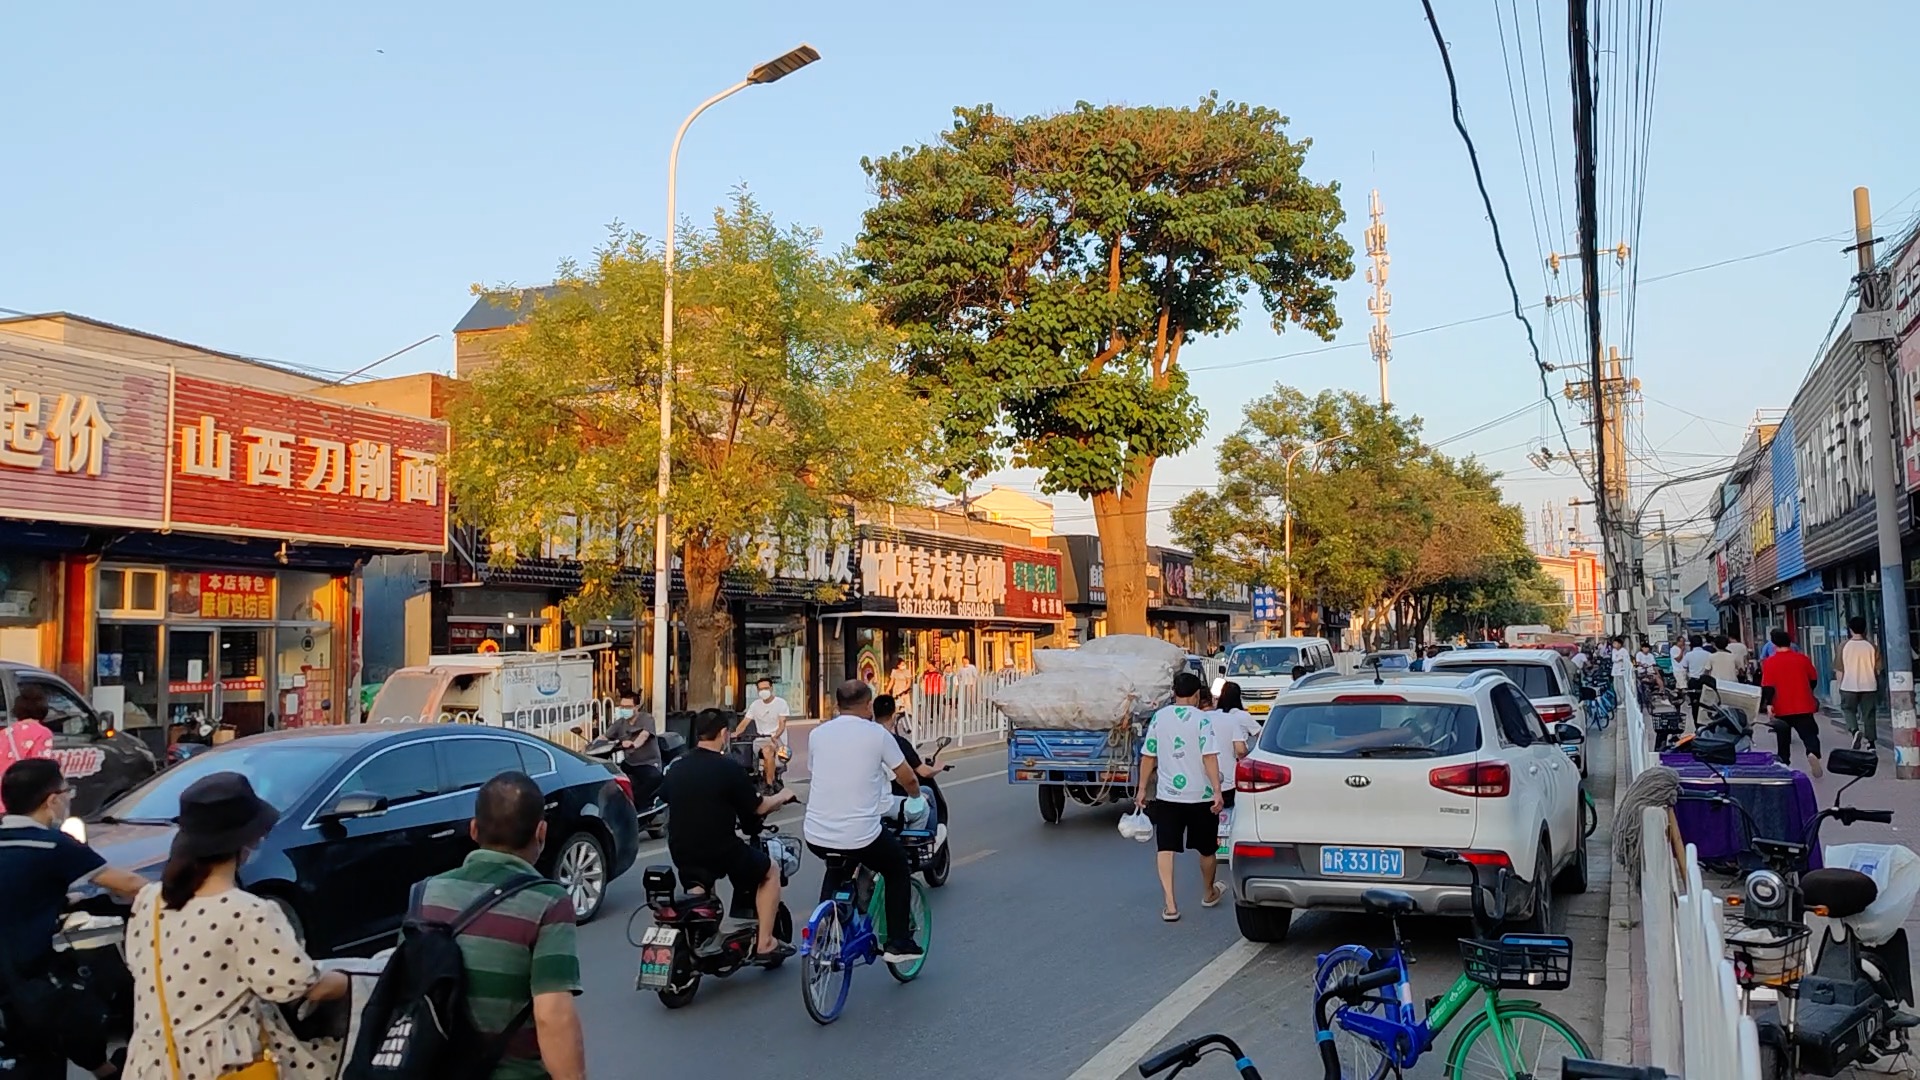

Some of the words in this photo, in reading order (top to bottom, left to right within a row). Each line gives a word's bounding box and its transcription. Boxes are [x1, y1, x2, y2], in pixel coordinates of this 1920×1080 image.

[0, 385, 113, 476] 起价
[182, 415, 438, 508] 山西刀削面
[208, 574, 266, 592] 本店特色
[897, 598, 951, 616] 13671393123
[1347, 776, 1368, 786] KIA
